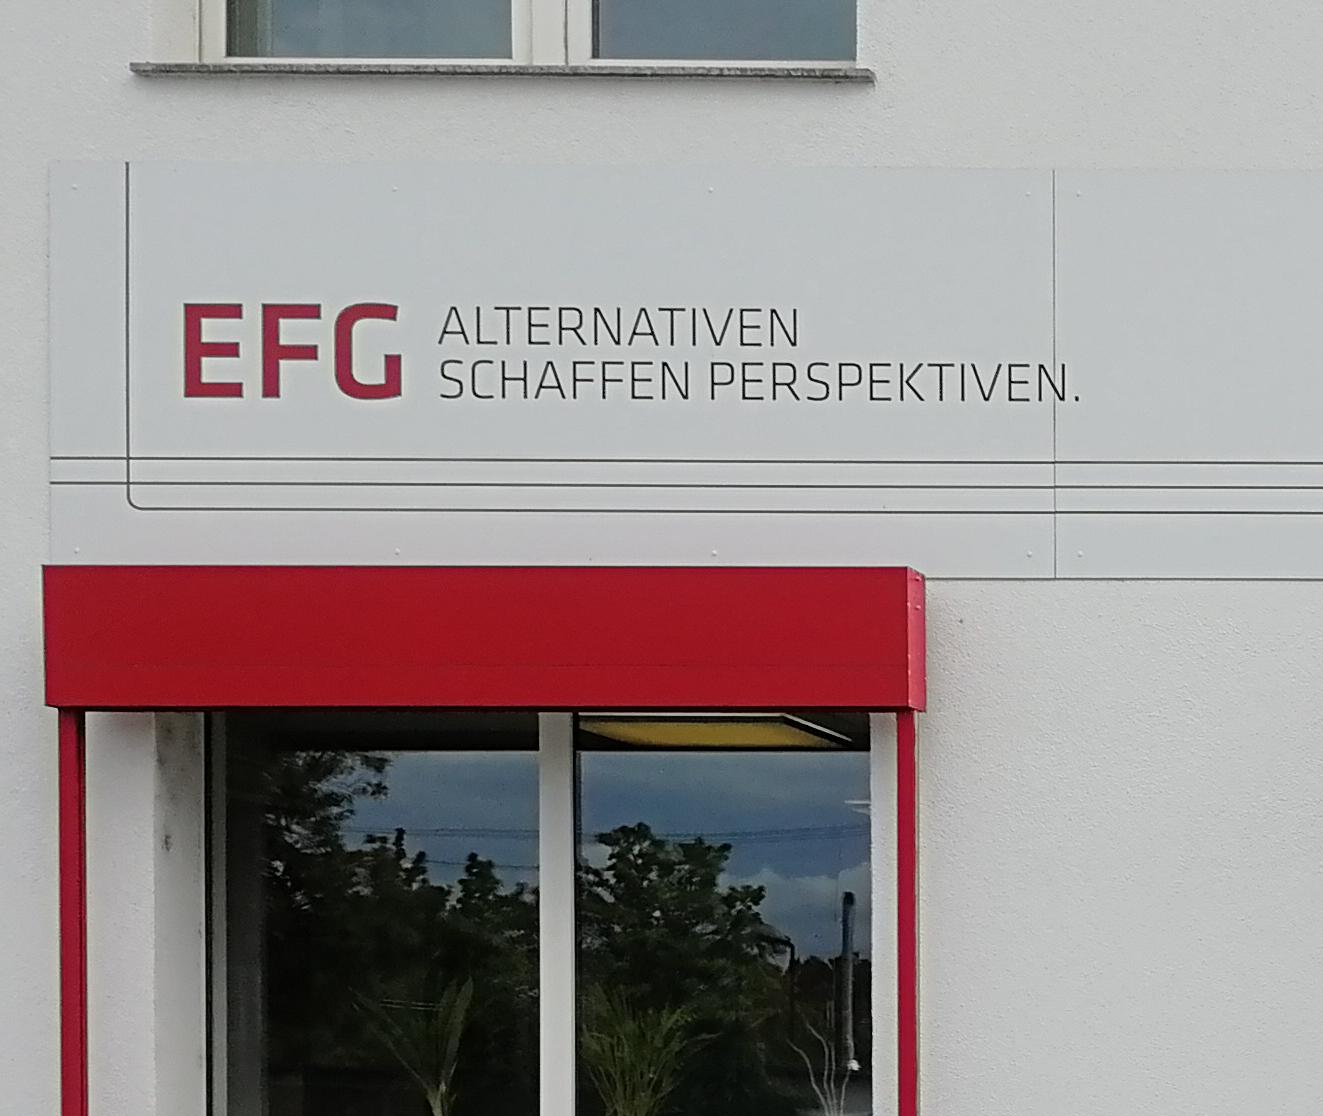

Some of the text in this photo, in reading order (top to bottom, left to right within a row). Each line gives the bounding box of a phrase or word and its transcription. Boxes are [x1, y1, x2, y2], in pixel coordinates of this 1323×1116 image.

[438, 306, 801, 348] ALTERNATIVEN
[182, 302, 403, 400] EFG
[438, 359, 1081, 404] SCHAFFEN PERSPEKTIVEN.
